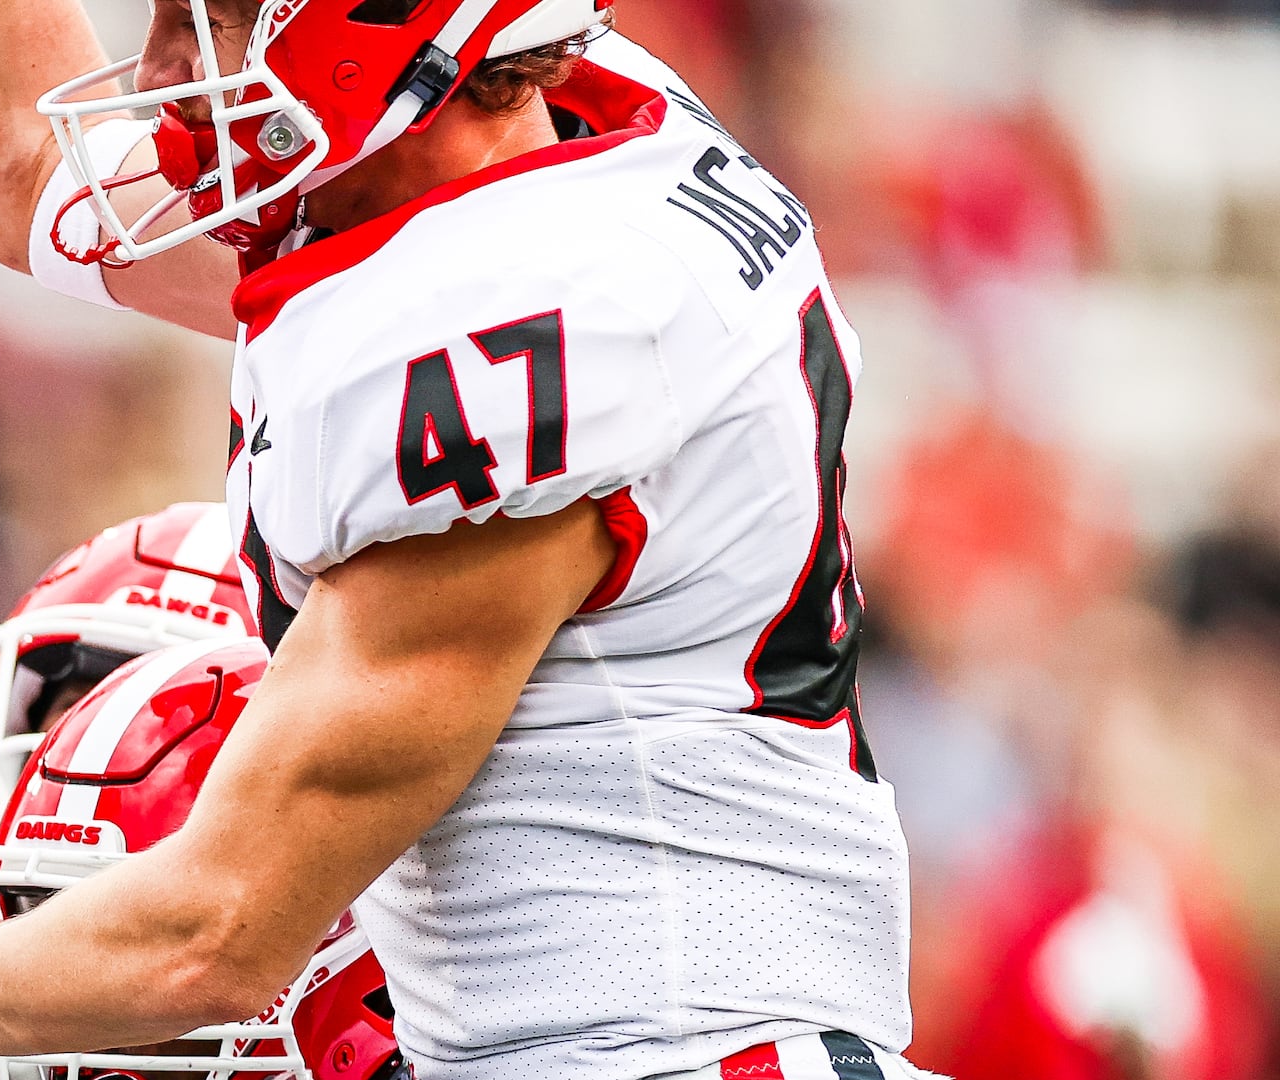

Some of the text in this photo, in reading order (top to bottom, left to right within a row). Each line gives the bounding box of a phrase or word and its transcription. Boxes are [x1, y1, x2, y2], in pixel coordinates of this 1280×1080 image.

[396, 308, 568, 510] 47
[126, 591, 229, 625] DAWGS
[15, 821, 102, 845] DAWGS
